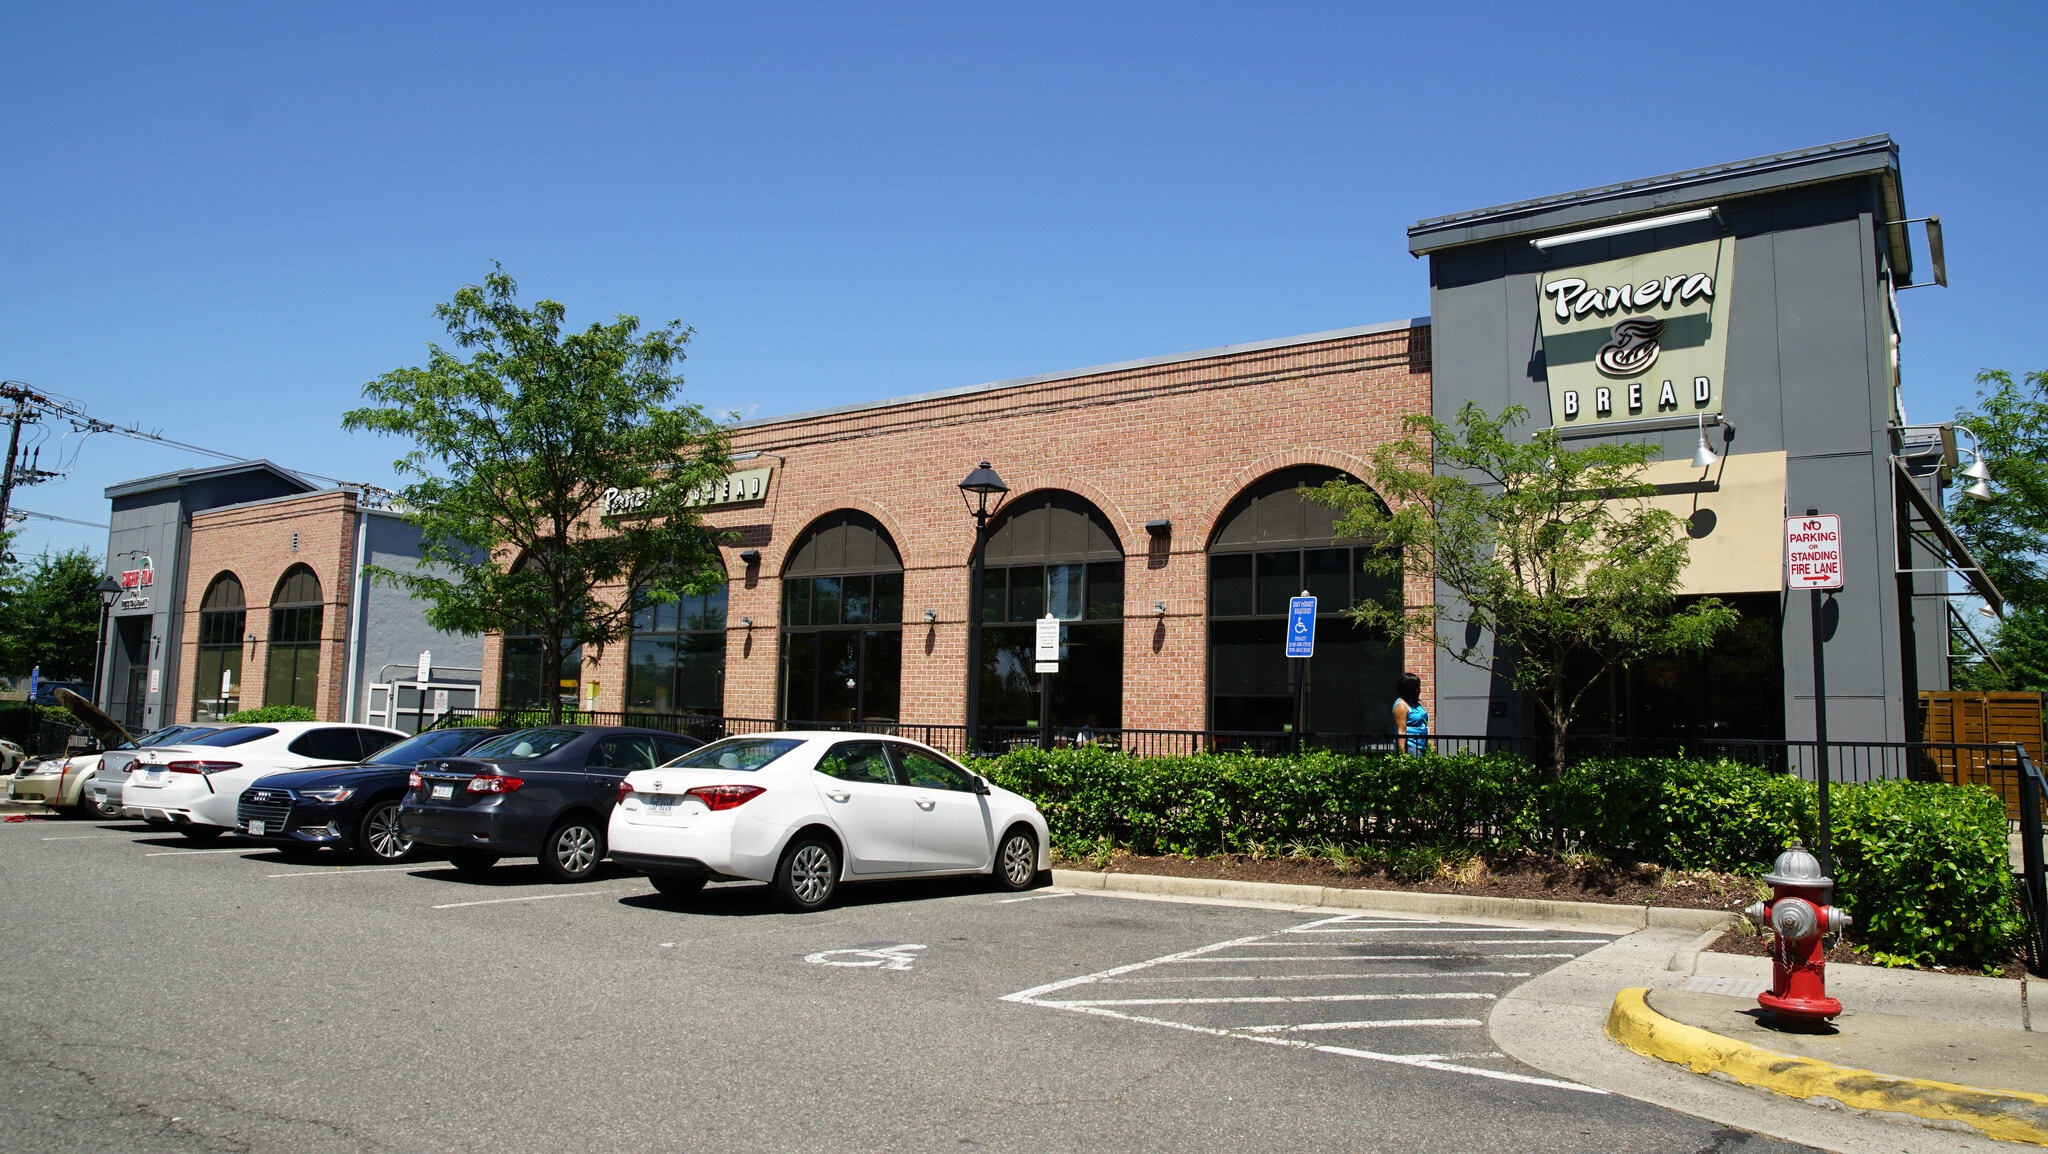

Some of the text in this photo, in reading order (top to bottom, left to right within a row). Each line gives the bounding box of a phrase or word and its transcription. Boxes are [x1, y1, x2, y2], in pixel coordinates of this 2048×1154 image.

[1545, 273, 1713, 318] Panera
[1565, 377, 1710, 415] BREAD
[1803, 521, 1822, 531] NO
[1789, 532, 1837, 543] PARKING
[1791, 551, 1838, 562] STANDING
[1791, 562, 1838, 575] FIRE LANE
